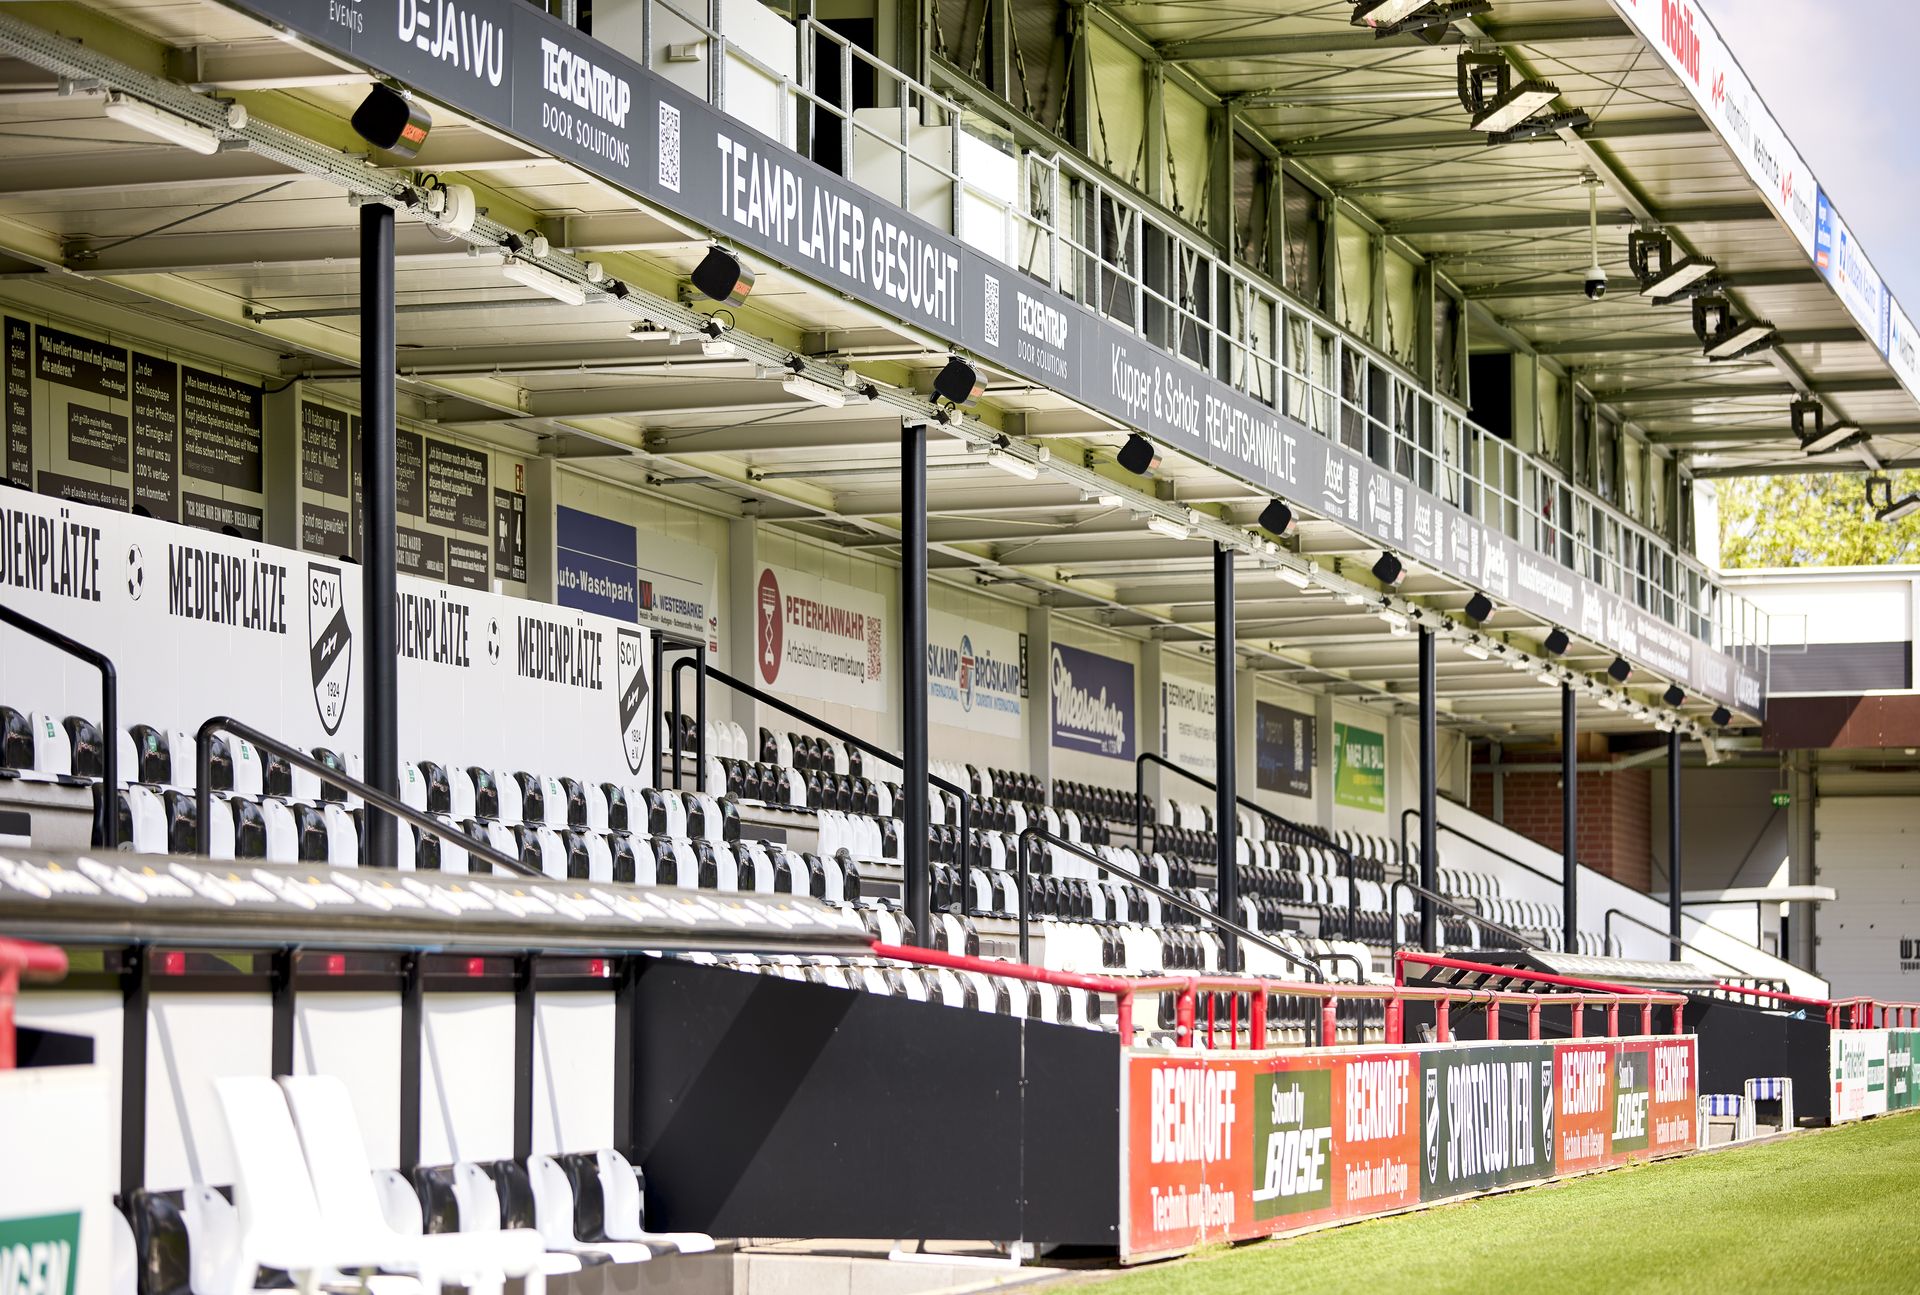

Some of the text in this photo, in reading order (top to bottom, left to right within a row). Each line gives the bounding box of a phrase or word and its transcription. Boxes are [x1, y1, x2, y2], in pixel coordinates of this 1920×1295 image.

[330, 0, 363, 33] EVENTS
[541, 37, 630, 128] TECKENTRUP
[543, 102, 630, 168] DOOR SOLUTIONS
[717, 133, 958, 326] TEAMPLAYER GESUCHT
[1017, 291, 1068, 351] TECKENTRUP
[143, 362, 152, 377] der
[1017, 339, 1067, 379] DOOR SOLUTIONS
[135, 380, 169, 405] Schlussphase
[135, 403, 175, 423] war der Pfosten
[209, 380, 217, 394] das
[228, 386, 237, 399] Der
[237, 389, 251, 404] Trainer
[1111, 343, 1296, 485] Küpper & Scholz RECHTSANWÄLTE
[135, 420, 173, 444] der Einzige auf
[136, 441, 171, 463] den wir uns zu
[136, 462, 147, 477] 100
[147, 464, 152, 478] %
[215, 448, 223, 461] 110
[1324, 447, 1344, 494] Asset
[71, 484, 86, 500] glaube
[99, 490, 111, 504] dass
[118, 494, 127, 507] das
[136, 485, 146, 497] sen
[304, 510, 323, 530] sind neu
[515, 513, 521, 552] 4
[1414, 495, 1431, 536] Asset
[0, 507, 100, 602] DIENPLÄTZE
[169, 543, 286, 634] MEDIENPLÄTZE
[312, 578, 336, 608] SCV
[558, 566, 633, 603] uto-Waschpark
[396, 590, 470, 667] DIENPLÄTZE
[786, 595, 864, 641] PETERHANWAHR
[518, 616, 602, 690] MEDIENPLÄTZE
[620, 641, 637, 666] SCV
[787, 640, 864, 684] Arbeitsbühnenvermietung
[928, 644, 1019, 695] SKAMP BRÖSKAMP
[327, 682, 340, 698] 1924
[1562, 1050, 1606, 1116] BECKHOFF
[1655, 1046, 1688, 1104] BECKHOFF
[1151, 1066, 1236, 1164] BECKHOFF
[1271, 1082, 1304, 1130] Sound by
[1346, 1059, 1409, 1143] BECKHOFF
[1447, 1061, 1535, 1182] SPORTCLUB VERL
[1612, 1092, 1648, 1141] BOSE
[1253, 1126, 1332, 1202] BOSE
[1563, 1129, 1604, 1163] Technik und Design
[1346, 1157, 1408, 1201] Technik und Design
[1150, 1182, 1235, 1233] Technik und Design
